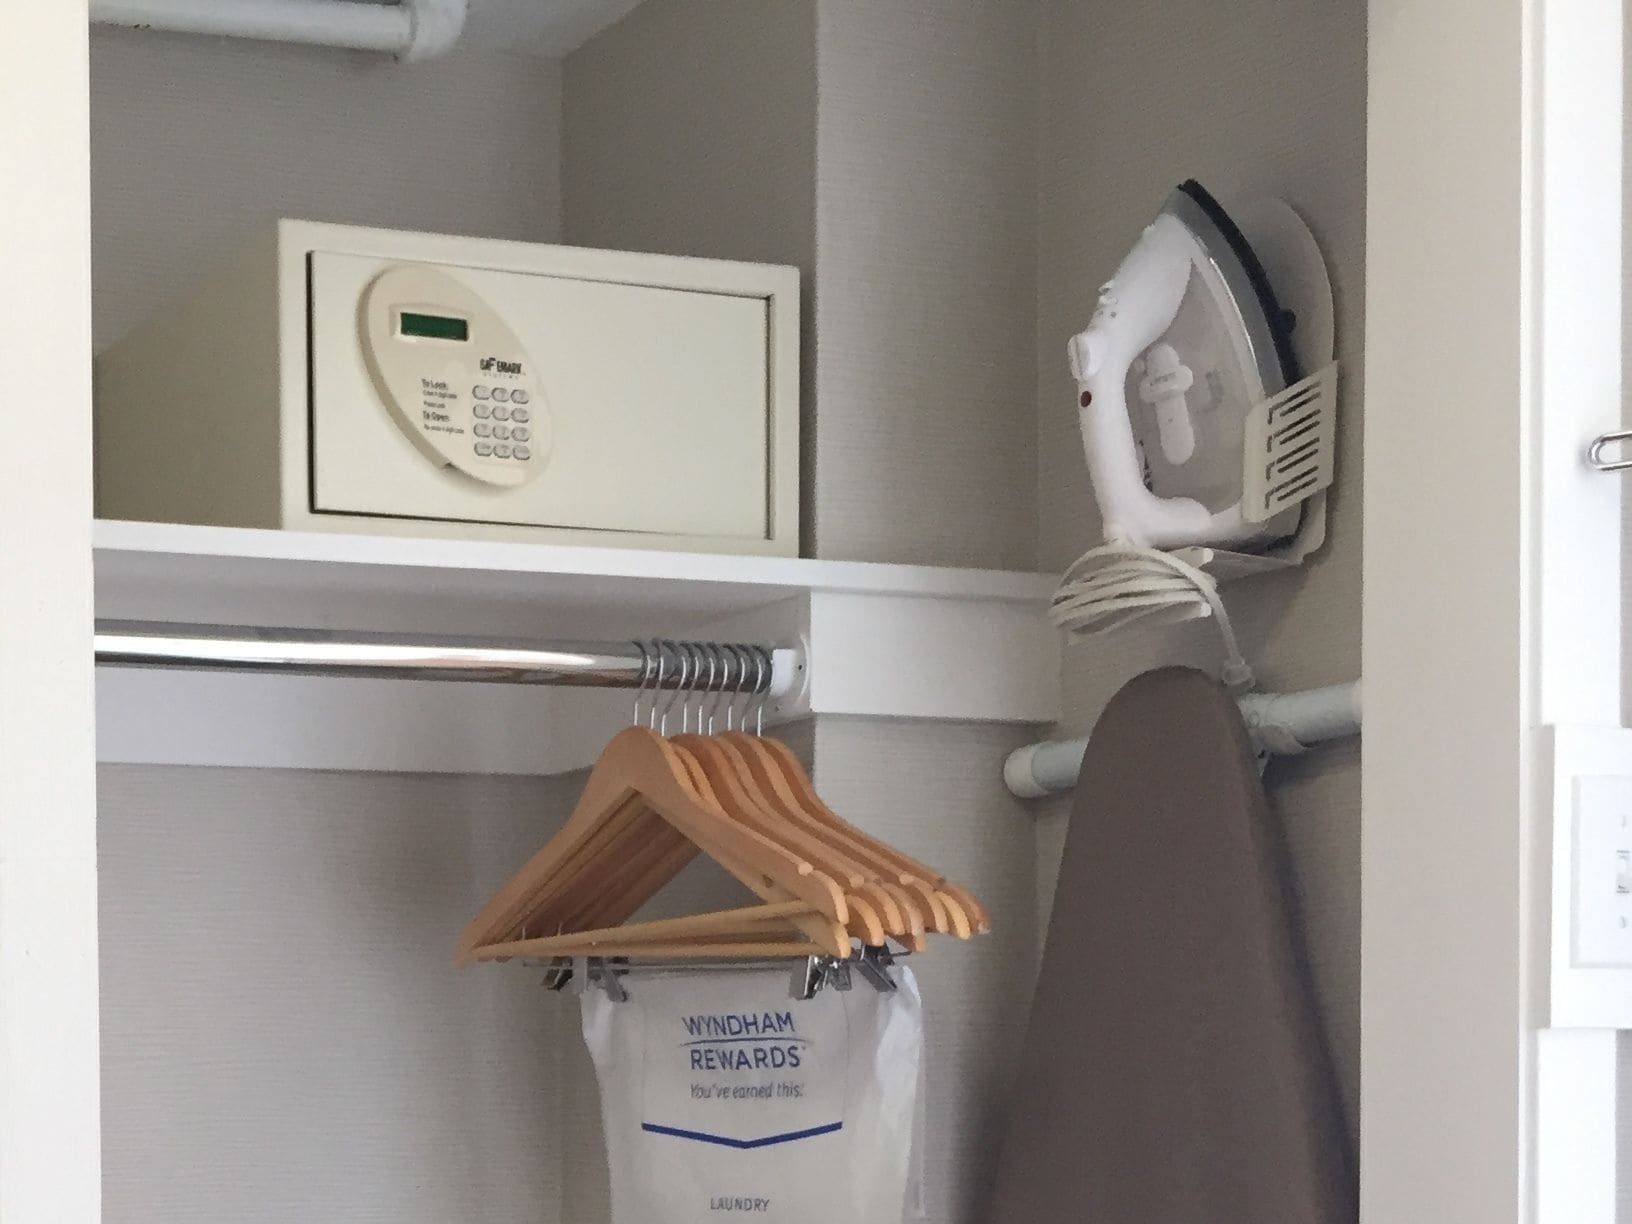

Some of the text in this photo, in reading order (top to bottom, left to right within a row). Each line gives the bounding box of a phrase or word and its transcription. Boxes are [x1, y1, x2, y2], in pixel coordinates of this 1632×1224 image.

[682, 1012, 796, 1036] WYNDHAM
[690, 1046, 802, 1071] REWARDS
[690, 1083, 731, 1100] You've
[732, 1083, 774, 1099] earned
[710, 1197, 770, 1212] LAUNDRY
